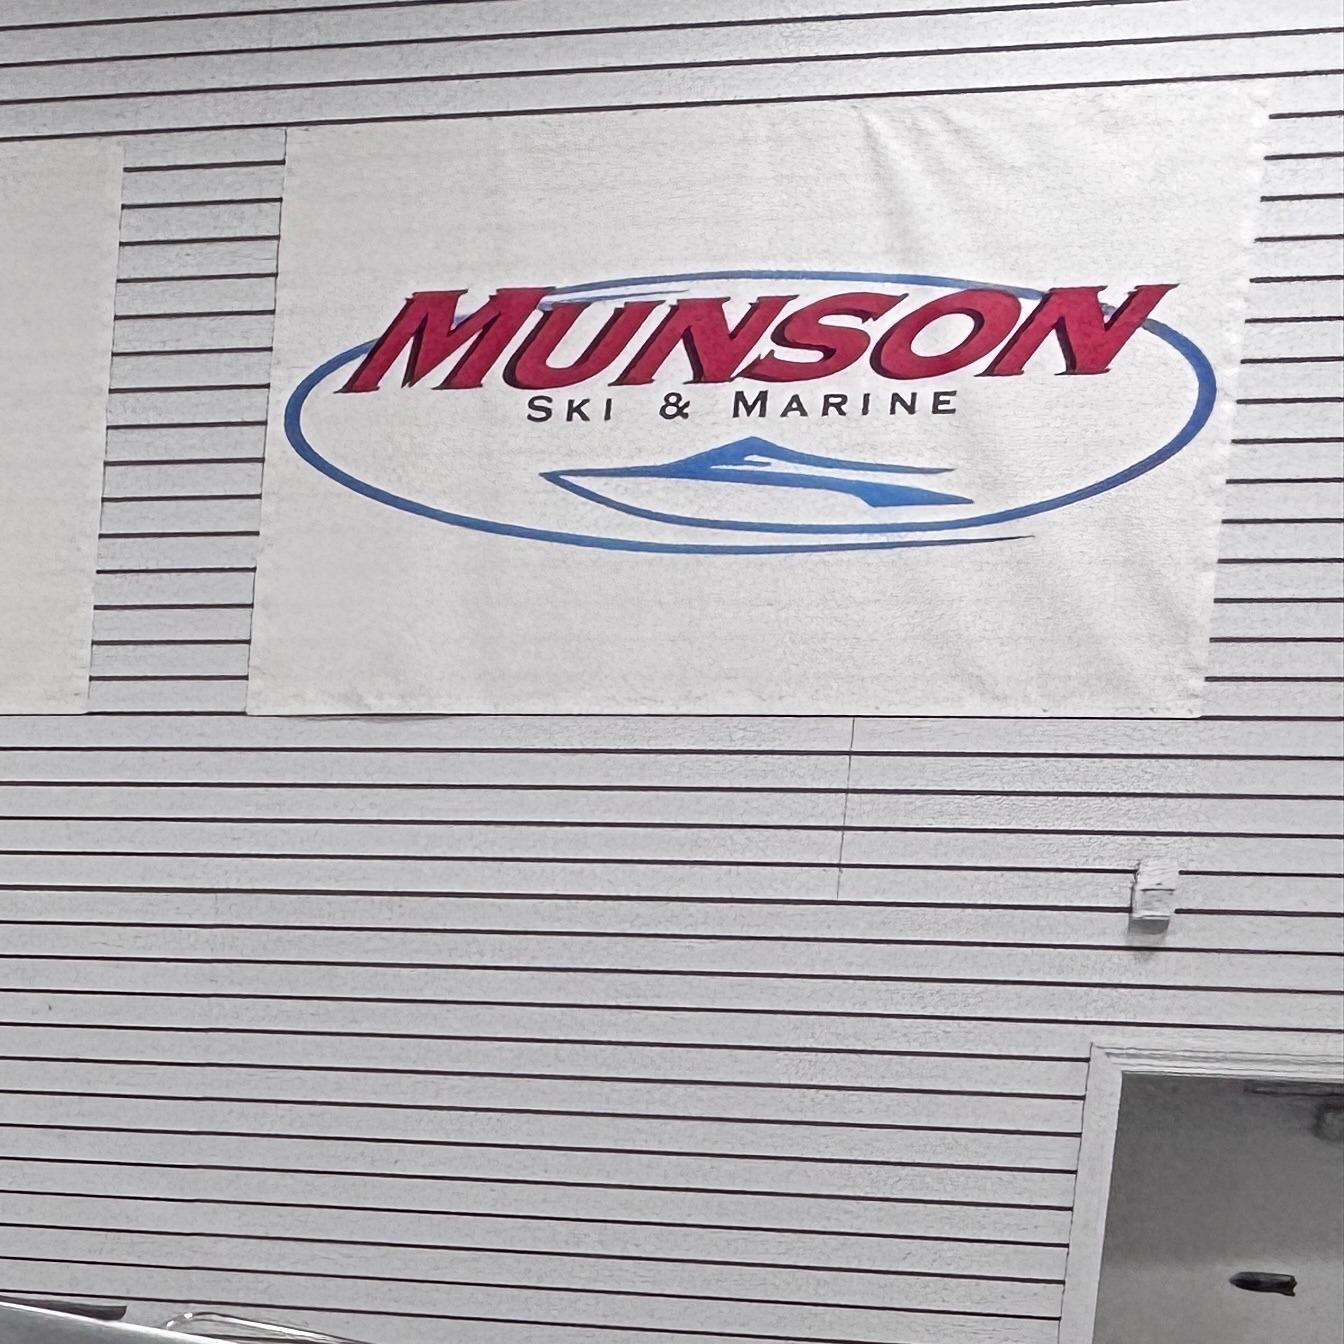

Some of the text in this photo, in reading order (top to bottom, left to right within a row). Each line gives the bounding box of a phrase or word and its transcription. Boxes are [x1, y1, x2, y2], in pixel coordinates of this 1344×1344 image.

[336, 284, 1176, 394] MUNSON
[526, 389, 958, 424] SKI & MARINE
